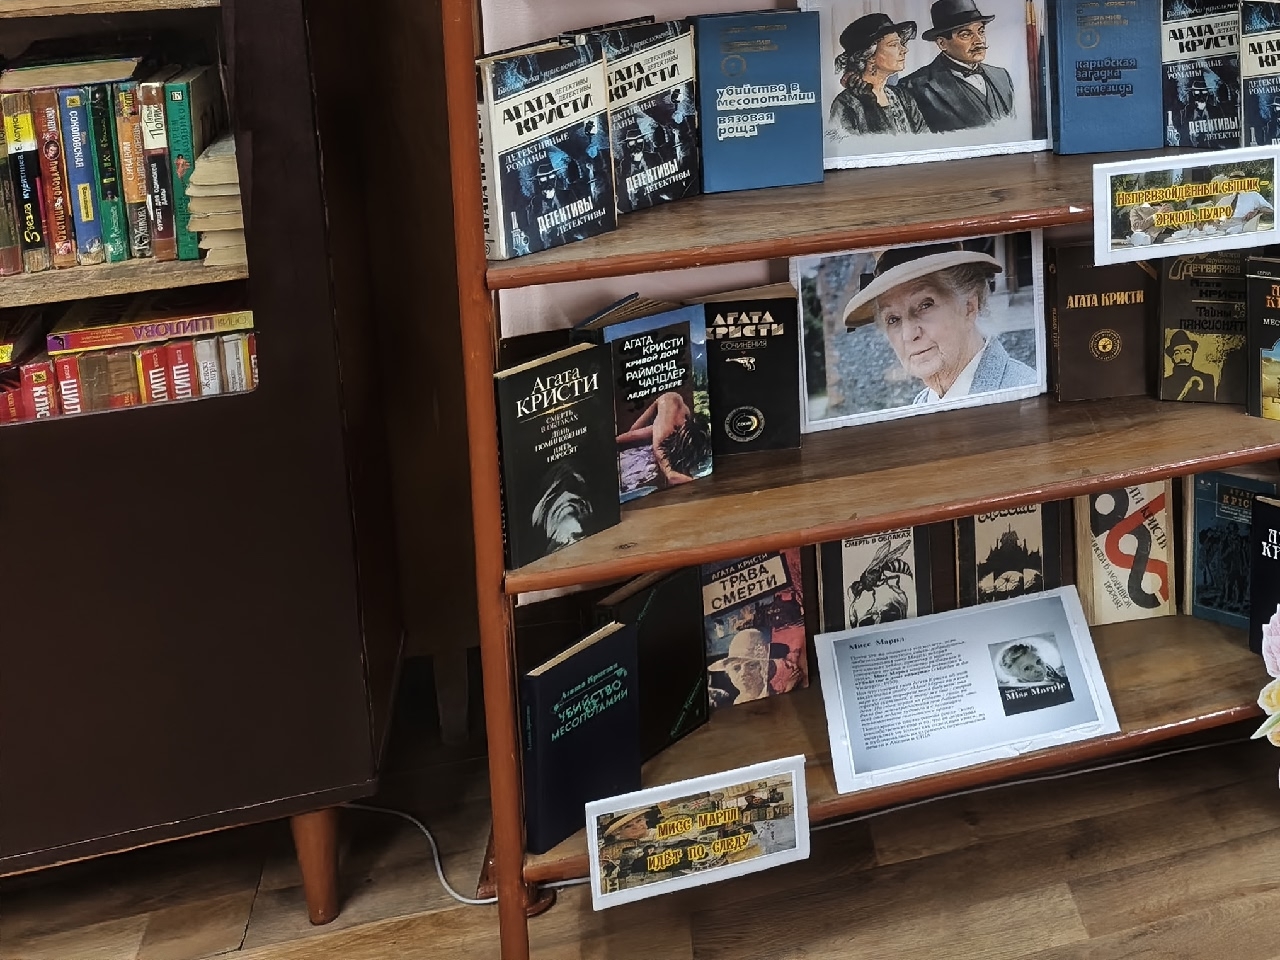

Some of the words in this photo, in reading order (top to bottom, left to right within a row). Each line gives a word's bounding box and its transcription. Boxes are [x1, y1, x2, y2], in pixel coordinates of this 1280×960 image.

[1168, 23, 1214, 43] АГАТА
[717, 93, 814, 107] месопотамии
[718, 84, 786, 99] убийство
[790, 83, 798, 91] в
[502, 93, 556, 125] АГАТА
[516, 93, 593, 136] КРИСТИ
[718, 113, 774, 125] вязовая
[69, 110, 84, 168] СОКОЛОВСКАЯ
[718, 124, 757, 139] роща
[505, 131, 570, 164] ДЕТЕКТИВНЫЕ
[505, 151, 547, 173] РОМАНЫ
[625, 158, 678, 193] ДЕТЕКТИВЫ
[1116, 181, 1220, 206] НЕПРЕВЗОЙДЁННЫЙ
[1221, 178, 1260, 193] СЫЩИК
[21, 202, 40, 243] Звезда
[537, 196, 593, 235] ДЕТЕКТИВЫ
[557, 209, 606, 236] ДЕТЕКТИВЫ
[1155, 210, 1198, 227] ЭРКЮЛЬ
[1200, 206, 1233, 222] ПУАРО
[1066, 292, 1098, 309] АГАТА
[1101, 290, 1144, 307] КРИСТИ
[132, 317, 214, 340] ШИЛОВА
[712, 310, 775, 326] АГАТА
[623, 335, 653, 350] АГАТА
[706, 323, 784, 339] КРИСТИ
[642, 337, 684, 355] КРИСТИ
[531, 366, 580, 394] Агата
[625, 360, 677, 381] РАЙМОНД
[638, 368, 686, 388] ЧАНДЛЕР
[516, 372, 599, 418] КРИСТИ
[844, 539, 870, 548] СМЕРТЬ
[877, 531, 912, 543] ОБЛАКАХ
[711, 565, 736, 580] АГАТА
[737, 552, 768, 571] КРИСТИ
[720, 563, 770, 590] ТРАВА
[711, 574, 779, 611] СМЕРТИ
[1030, 681, 1066, 696] Marple
[551, 688, 628, 741] МЕСОПОТАМИИ
[657, 818, 693, 839] МИСС
[698, 807, 739, 828] МАРПЛ
[647, 848, 682, 871] ИДЁТ
[688, 844, 705, 860] ПО
[711, 833, 751, 854] СЛЕДУ
